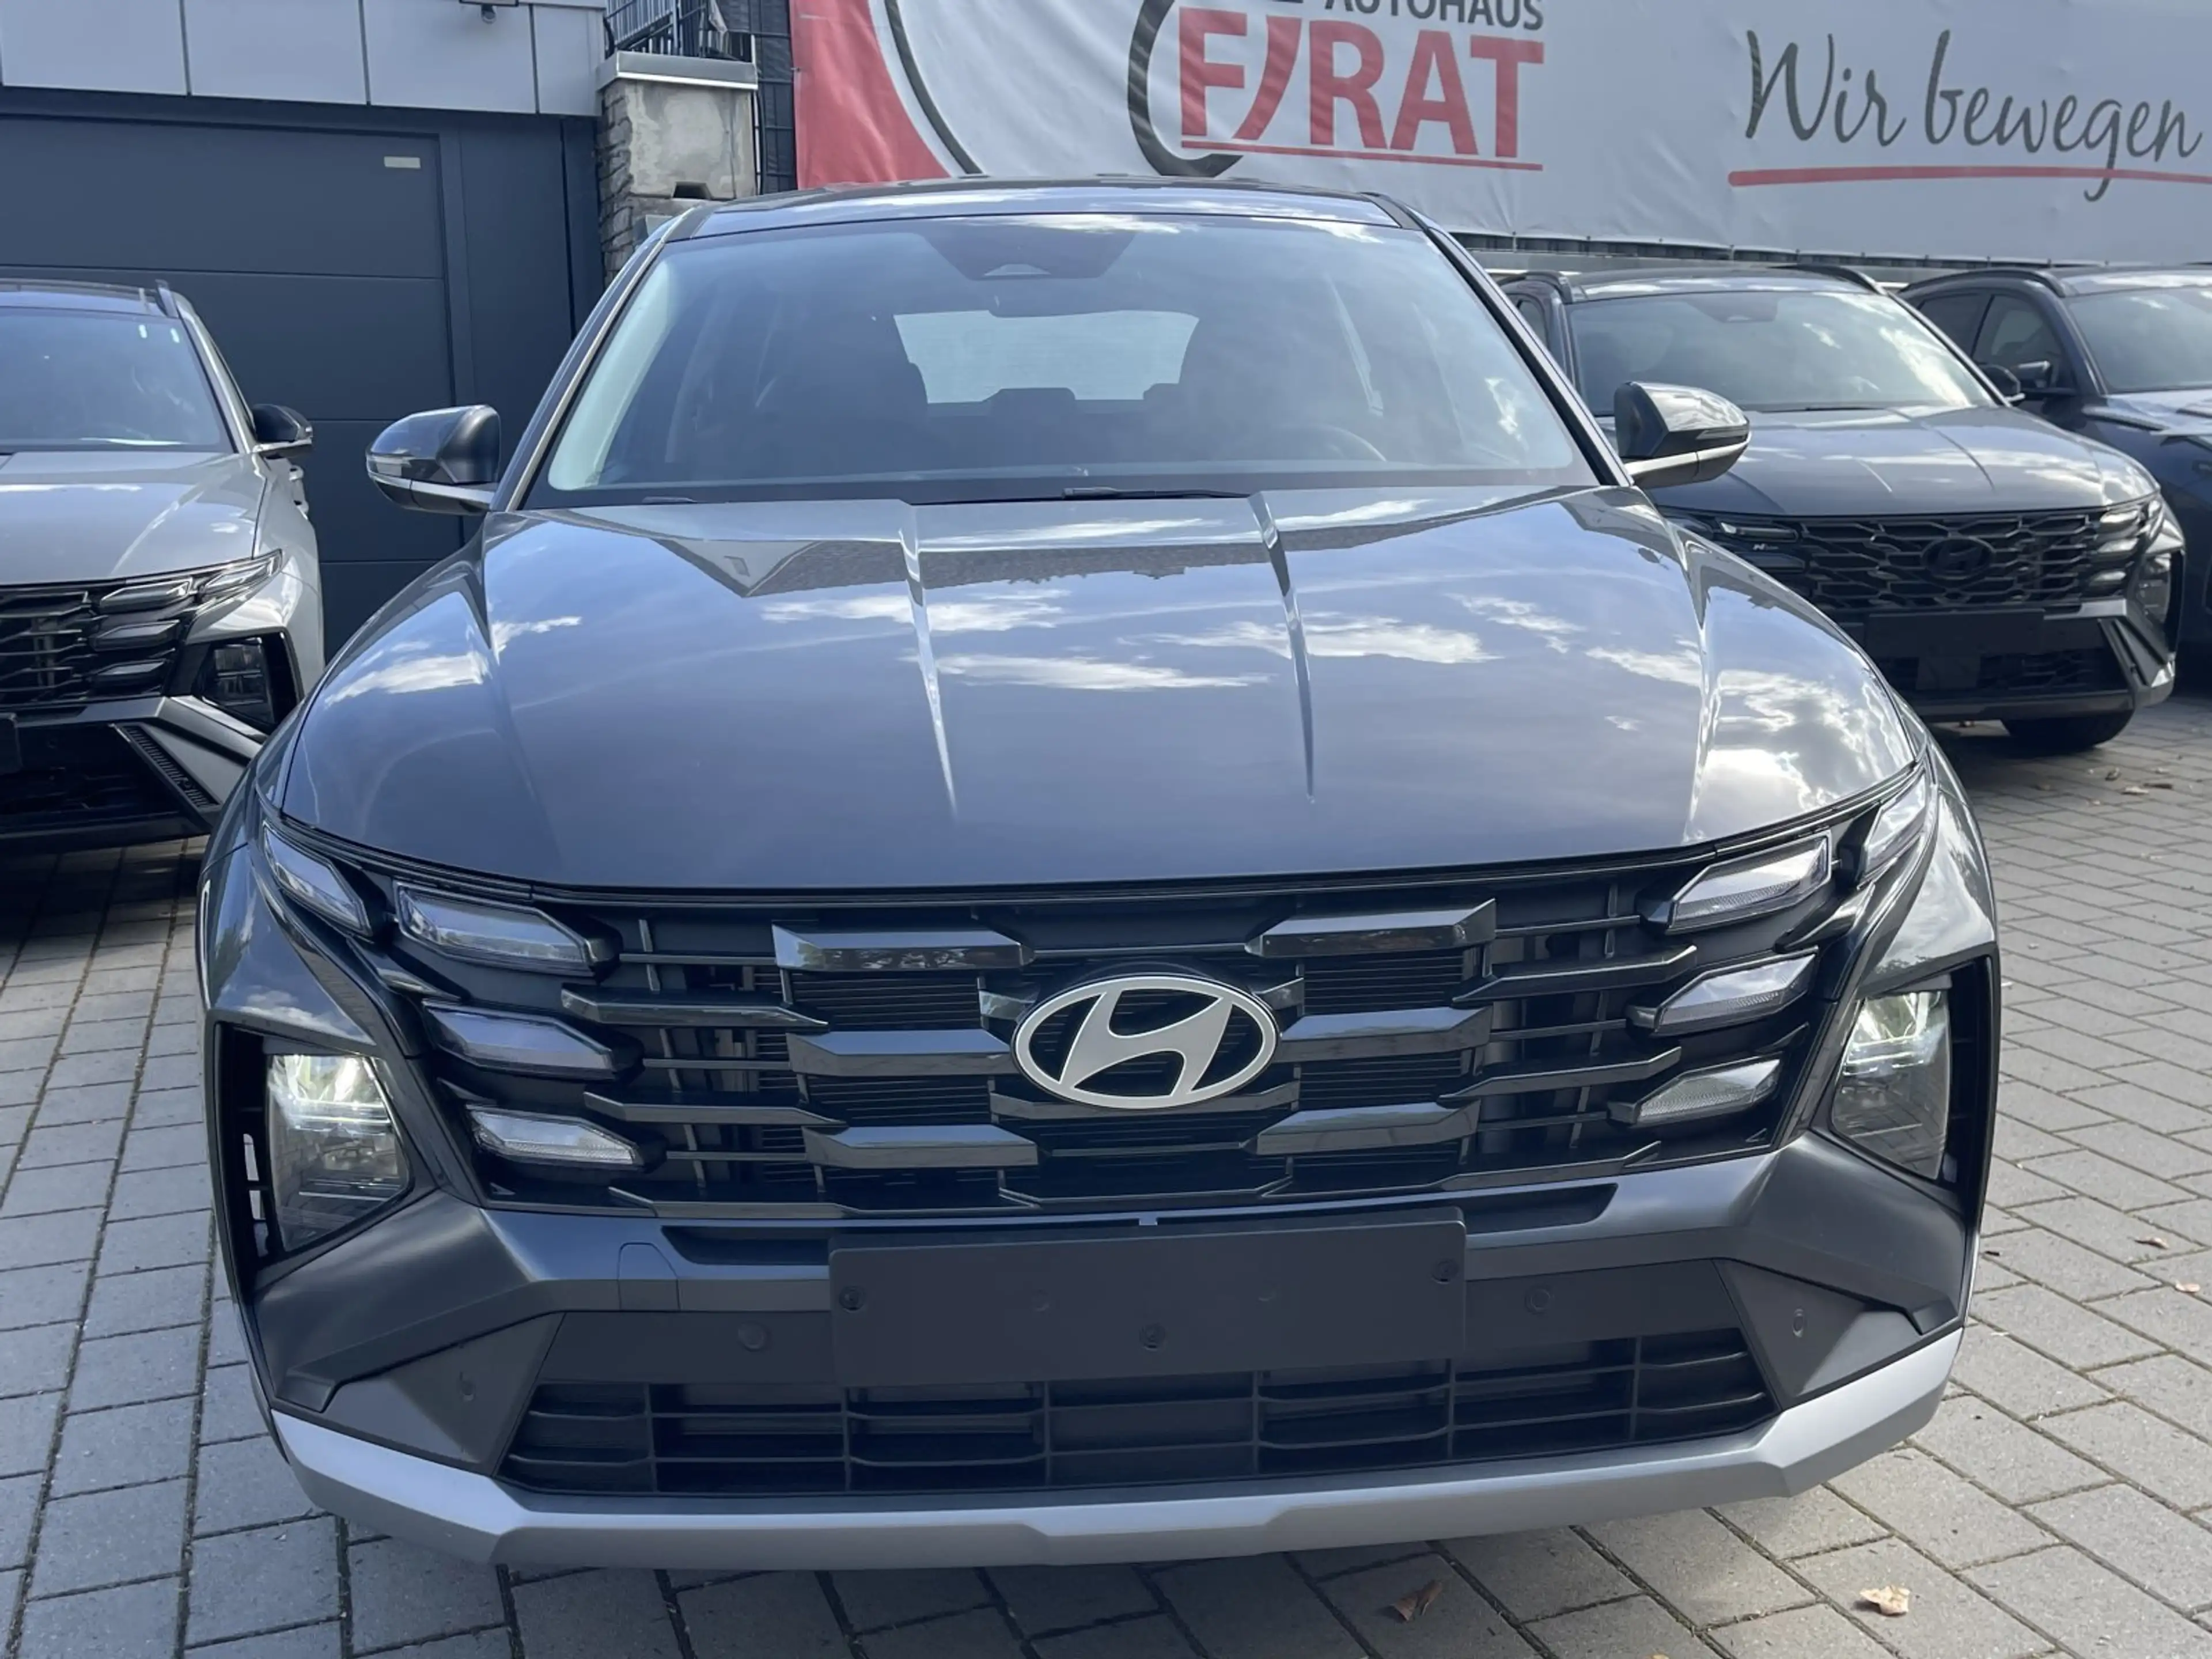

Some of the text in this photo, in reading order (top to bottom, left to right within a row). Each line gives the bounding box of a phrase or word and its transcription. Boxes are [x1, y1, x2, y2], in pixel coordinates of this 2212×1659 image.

[1323, 0, 1543, 31] HAUS
[1745, 29, 2202, 202] Wir bewegen
